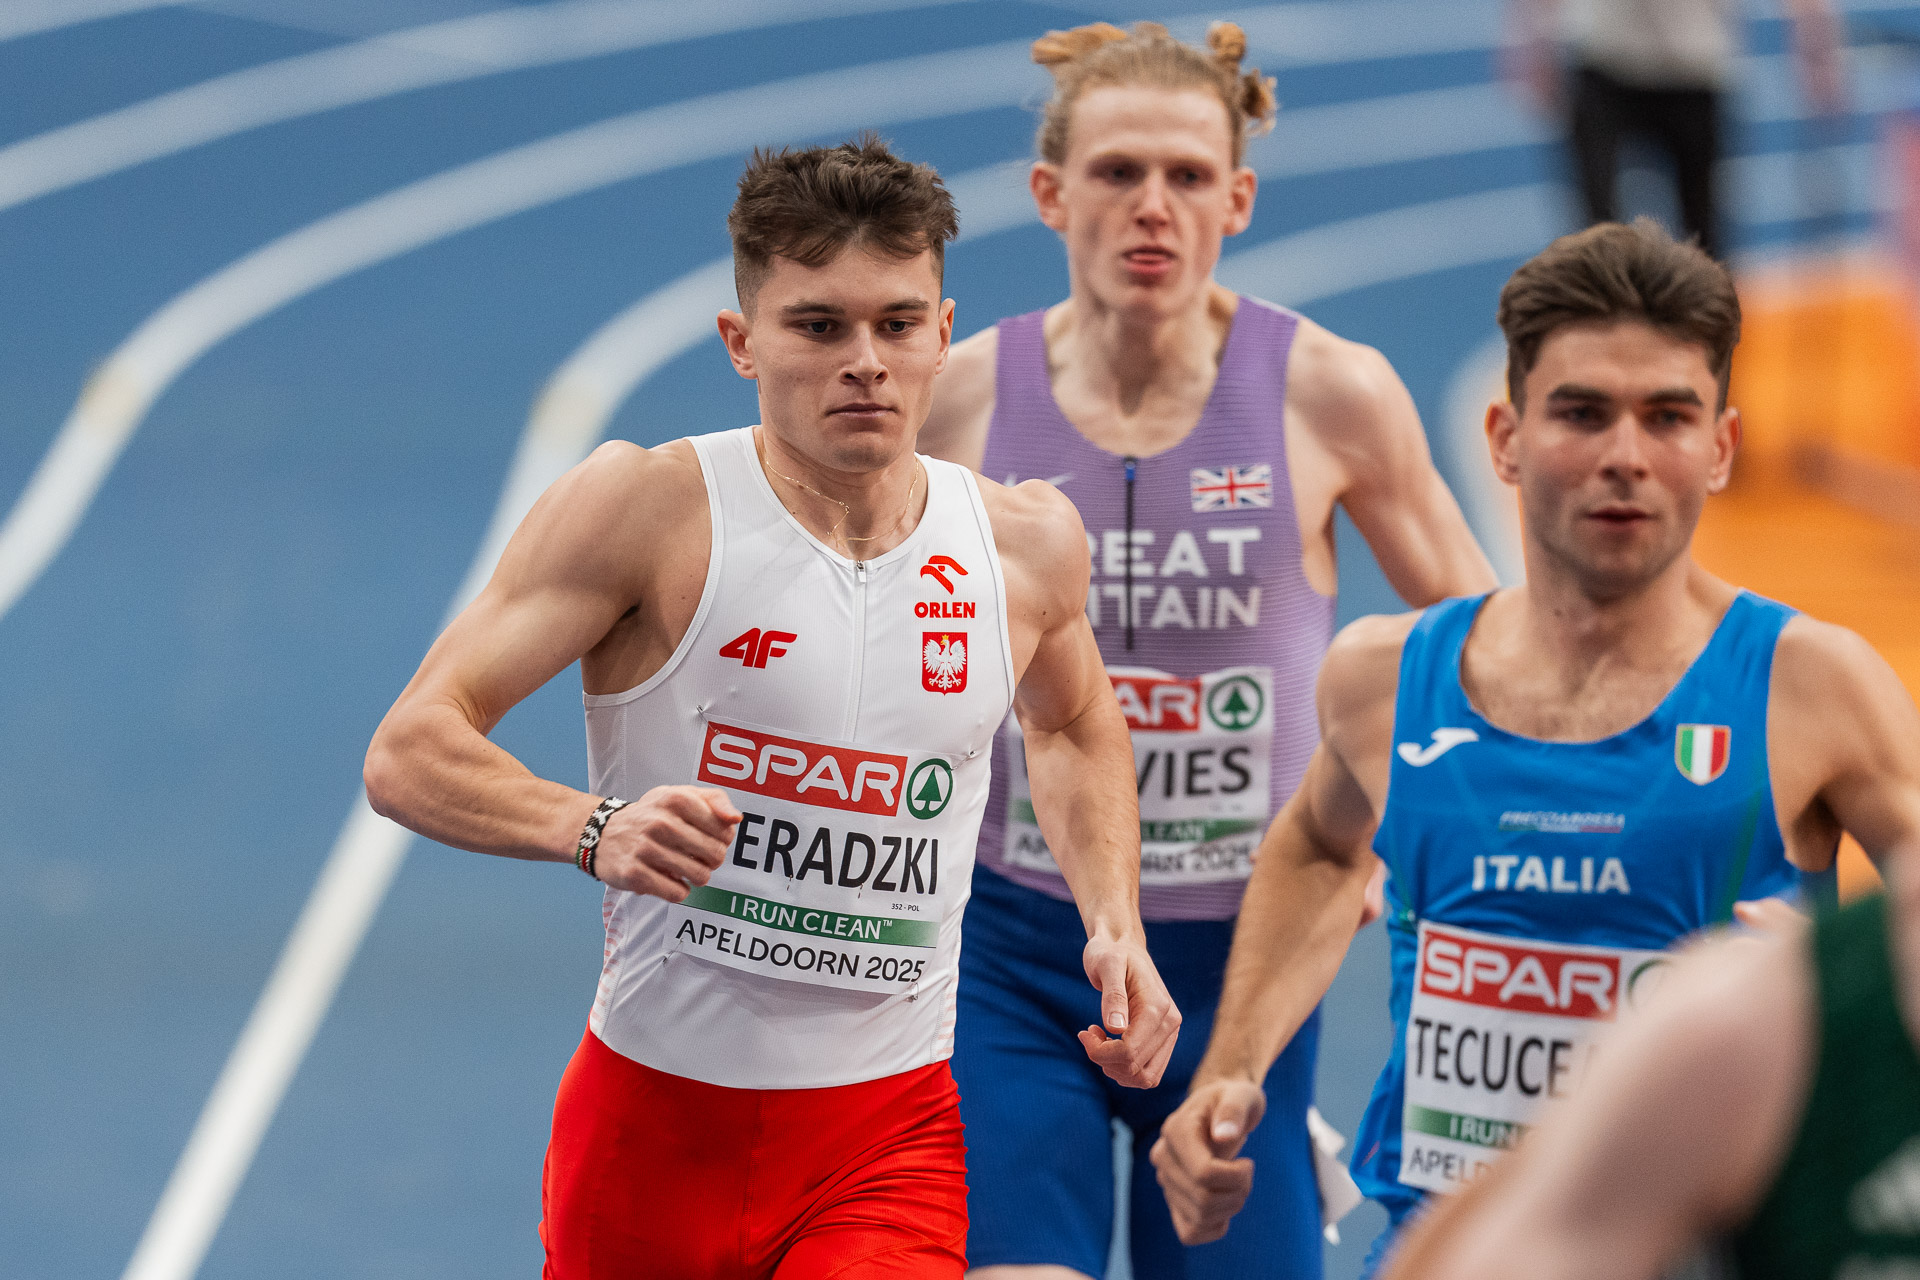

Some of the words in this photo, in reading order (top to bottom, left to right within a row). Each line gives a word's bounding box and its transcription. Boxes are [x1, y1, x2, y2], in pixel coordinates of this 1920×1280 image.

[1087, 527, 1261, 578] EAT
[914, 601, 976, 619] ORLEN
[1087, 583, 1263, 630] ITAIN
[719, 627, 798, 669] 4F
[1112, 681, 1197, 727] AR
[706, 732, 900, 807] SPAR
[1138, 746, 1252, 799] VIES
[732, 811, 939, 896] ERADZKI
[1472, 854, 1631, 895] ITALIA
[730, 895, 737, 914] I
[742, 898, 798, 928] RUN
[891, 903, 903, 911] 352
[907, 904, 920, 912] POL
[675, 919, 860, 978] APELDOORN
[864, 956, 926, 983] 2025
[1424, 939, 1614, 1012] SPAR
[1414, 1016, 1573, 1098] TECUCE
